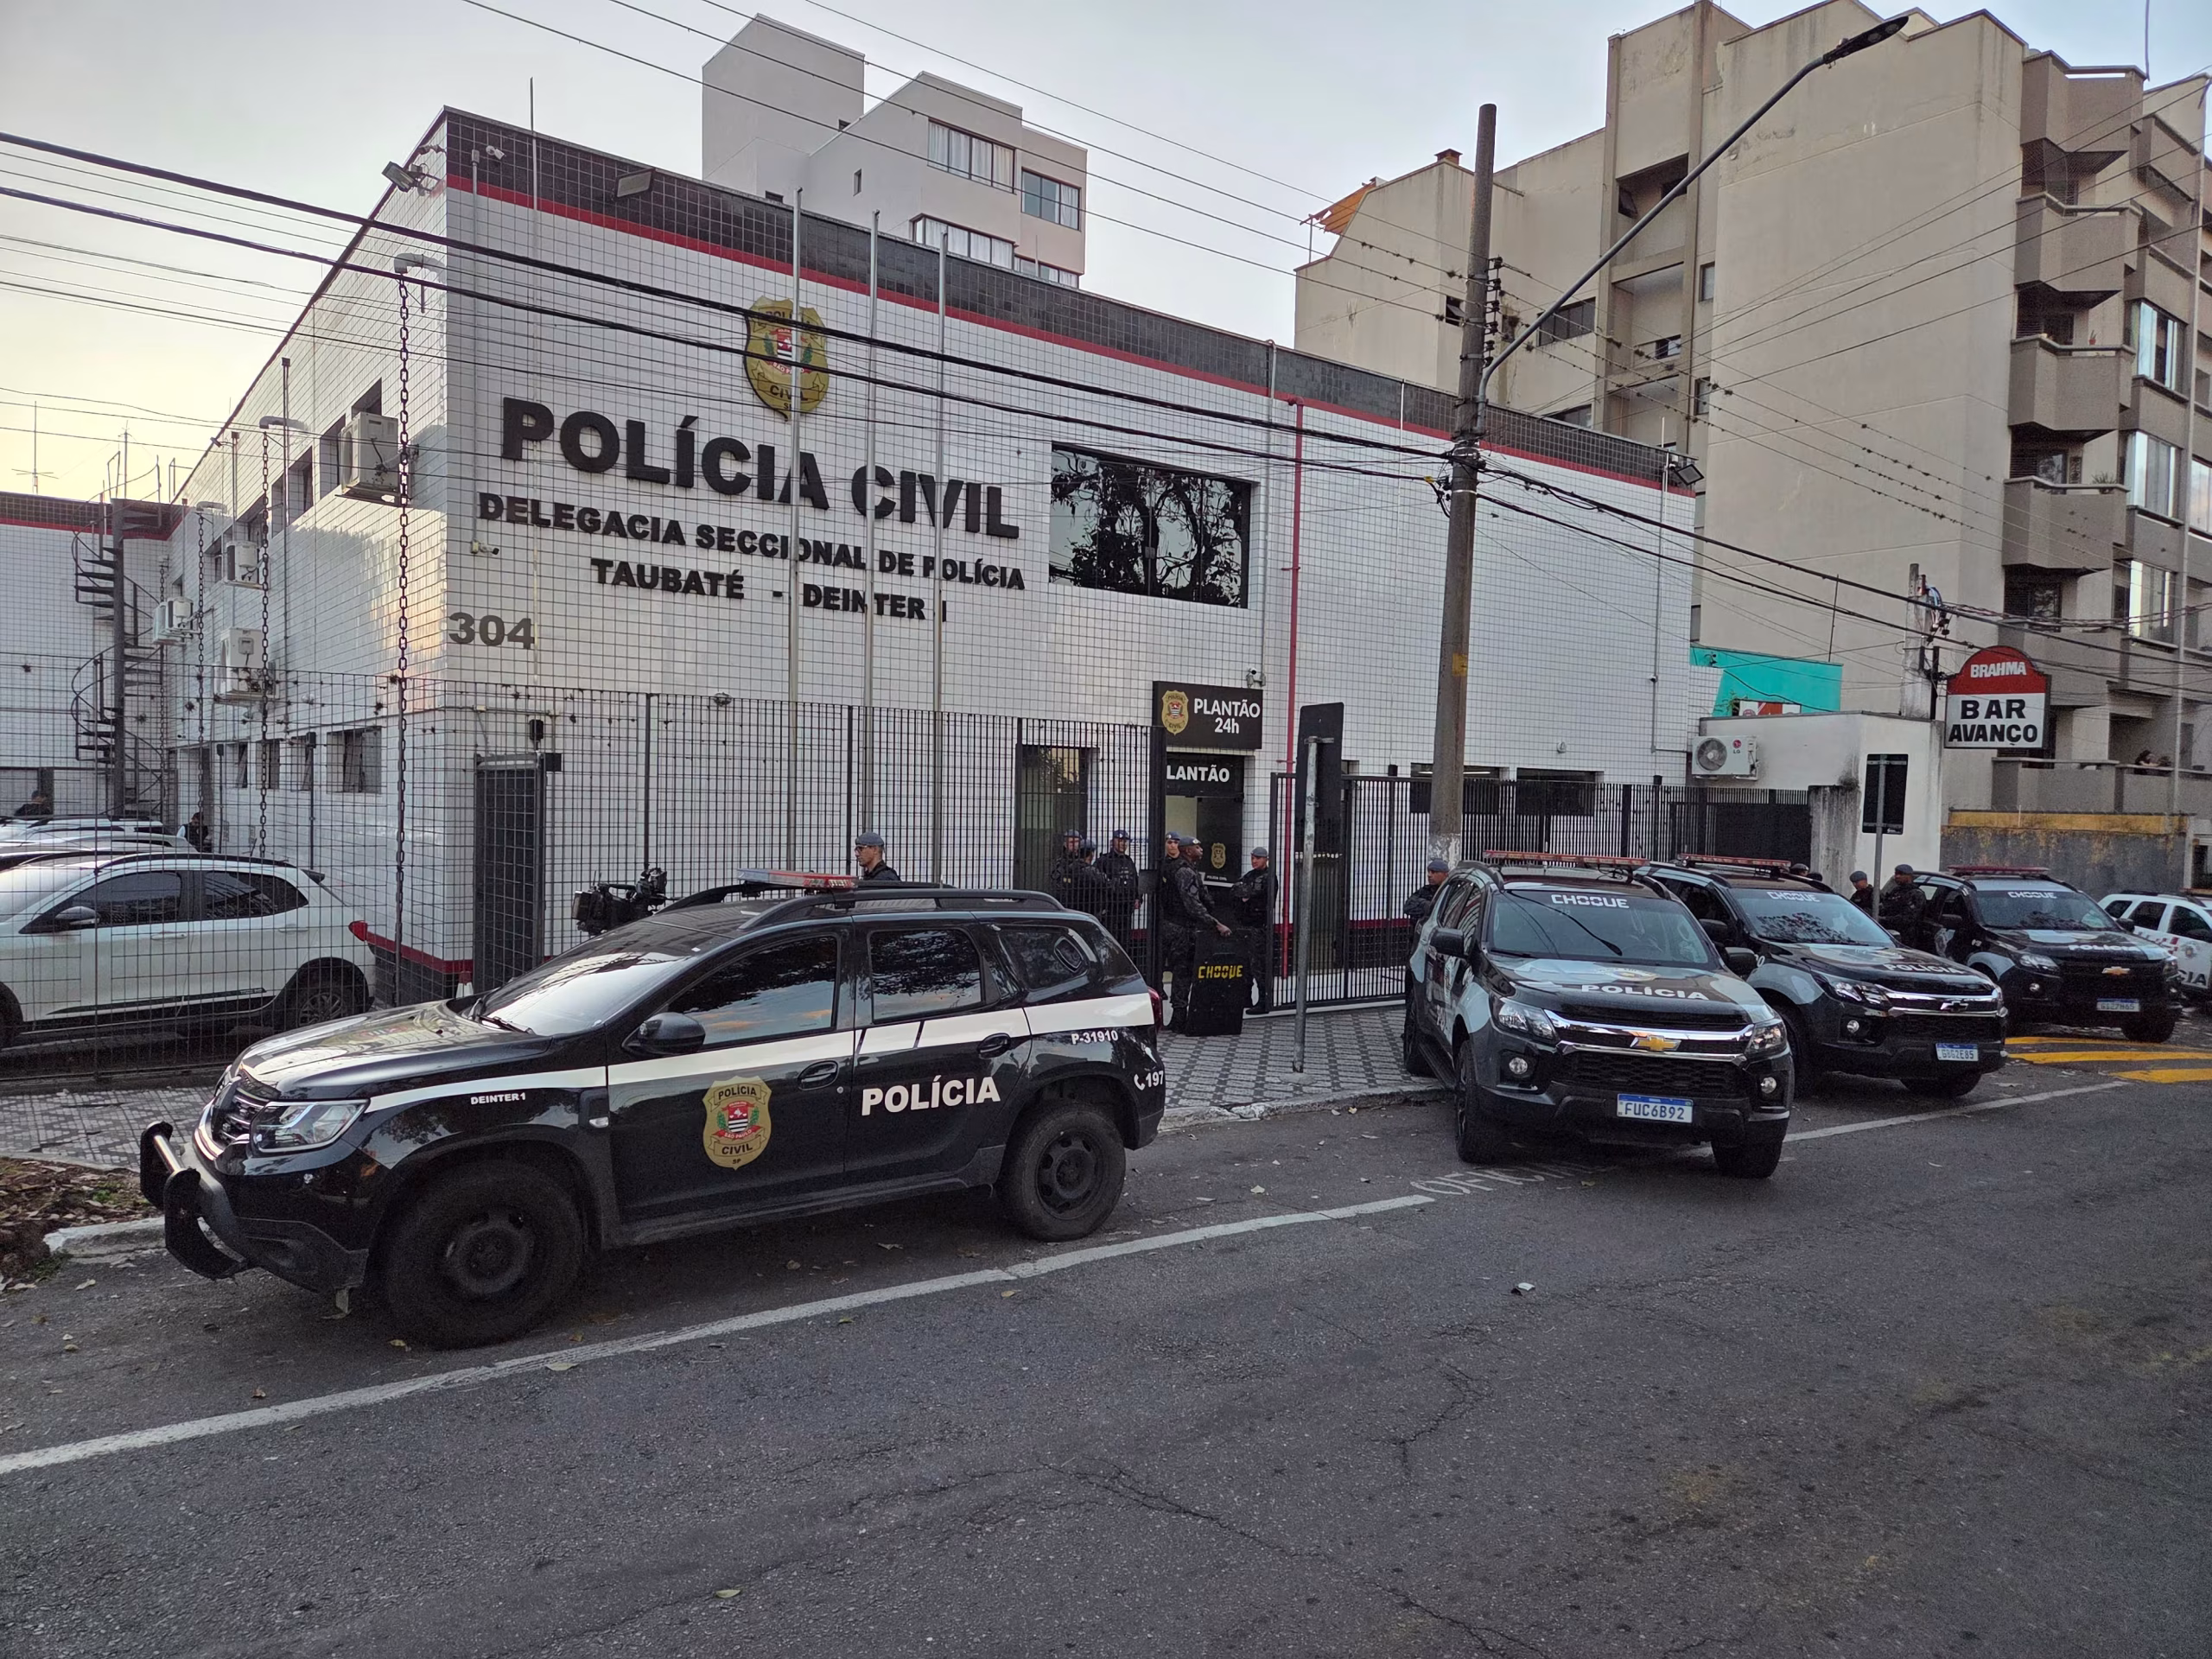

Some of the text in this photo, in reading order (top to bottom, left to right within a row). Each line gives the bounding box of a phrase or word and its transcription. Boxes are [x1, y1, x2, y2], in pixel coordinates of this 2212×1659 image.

[501, 397, 1020, 539] POLÍCIA CIVIL
[479, 492, 1026, 591] DELEGACIA SECCIONAL DE POLÍCIA
[591, 557, 745, 600] TAUBATÉ
[803, 583, 925, 620] DEINTER
[448, 612, 535, 649] 304
[1970, 662, 2026, 677] BRAHMA
[1194, 698, 1261, 718] PLANTÃO
[1961, 699, 2025, 719] BAR
[1214, 717, 1240, 734] 24h
[1948, 724, 2037, 746] AVANÇO
[1166, 764, 1230, 783] LANTÃO
[1551, 894, 1630, 908] CHOQUE
[1766, 891, 1821, 902] CHOQUE
[1198, 965, 1243, 979] CHOQUE
[1884, 963, 1966, 974] POLÍCIA
[1581, 984, 1709, 1001] POLÍCIA
[1071, 1030, 1118, 1045] P-31910
[1146, 1071, 1164, 1087] 197
[470, 1092, 526, 1105] DEINTER 1
[718, 1084, 757, 1100] POLÍCIA
[861, 1075, 1001, 1116] POLÍCIA
[1624, 1103, 1684, 1120] FUC6B92
[735, 1129, 752, 1139] PAULO
[721, 1143, 753, 1155] CIVIL
